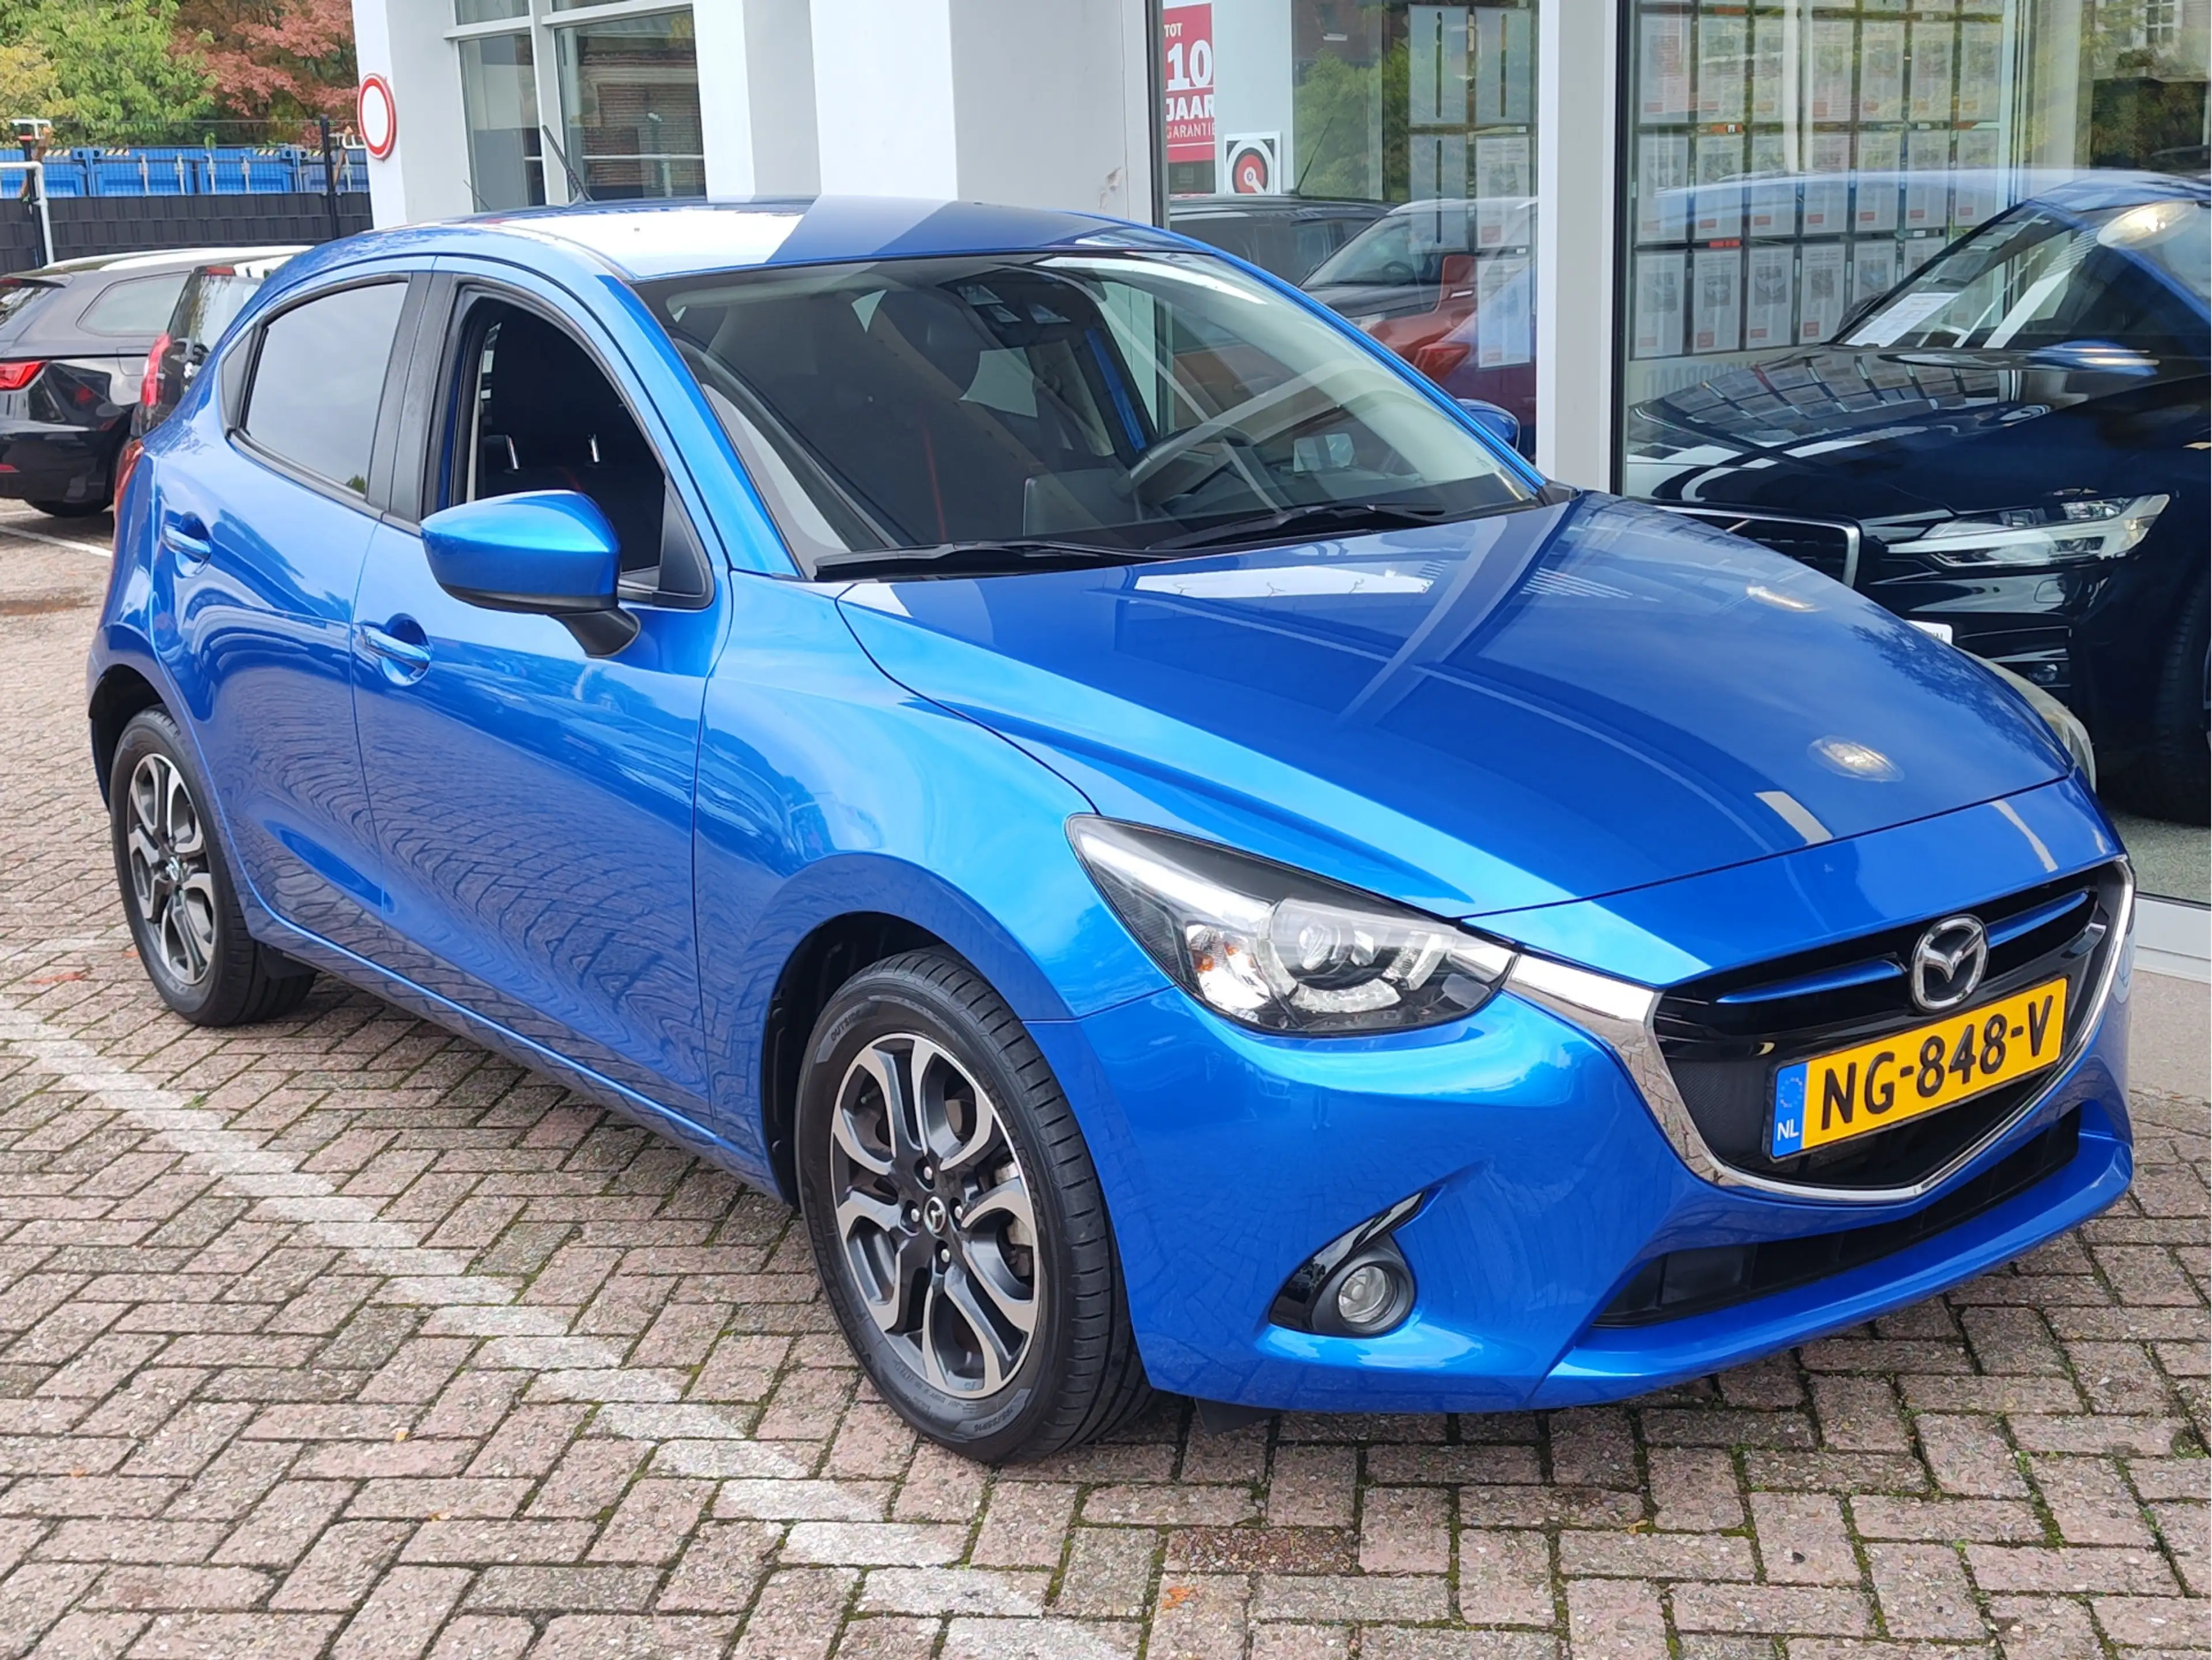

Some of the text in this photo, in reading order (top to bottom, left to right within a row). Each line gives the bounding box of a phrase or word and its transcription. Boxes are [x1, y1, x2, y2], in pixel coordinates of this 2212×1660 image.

[1164, 22, 1182, 37] TOT
[1167, 39, 1213, 90] 10
[1166, 94, 1215, 122] JAAR
[1166, 122, 1215, 139] GARANTIE
[1821, 995, 2053, 1130] NG-848-V
[1777, 1118, 1799, 1141] NL
